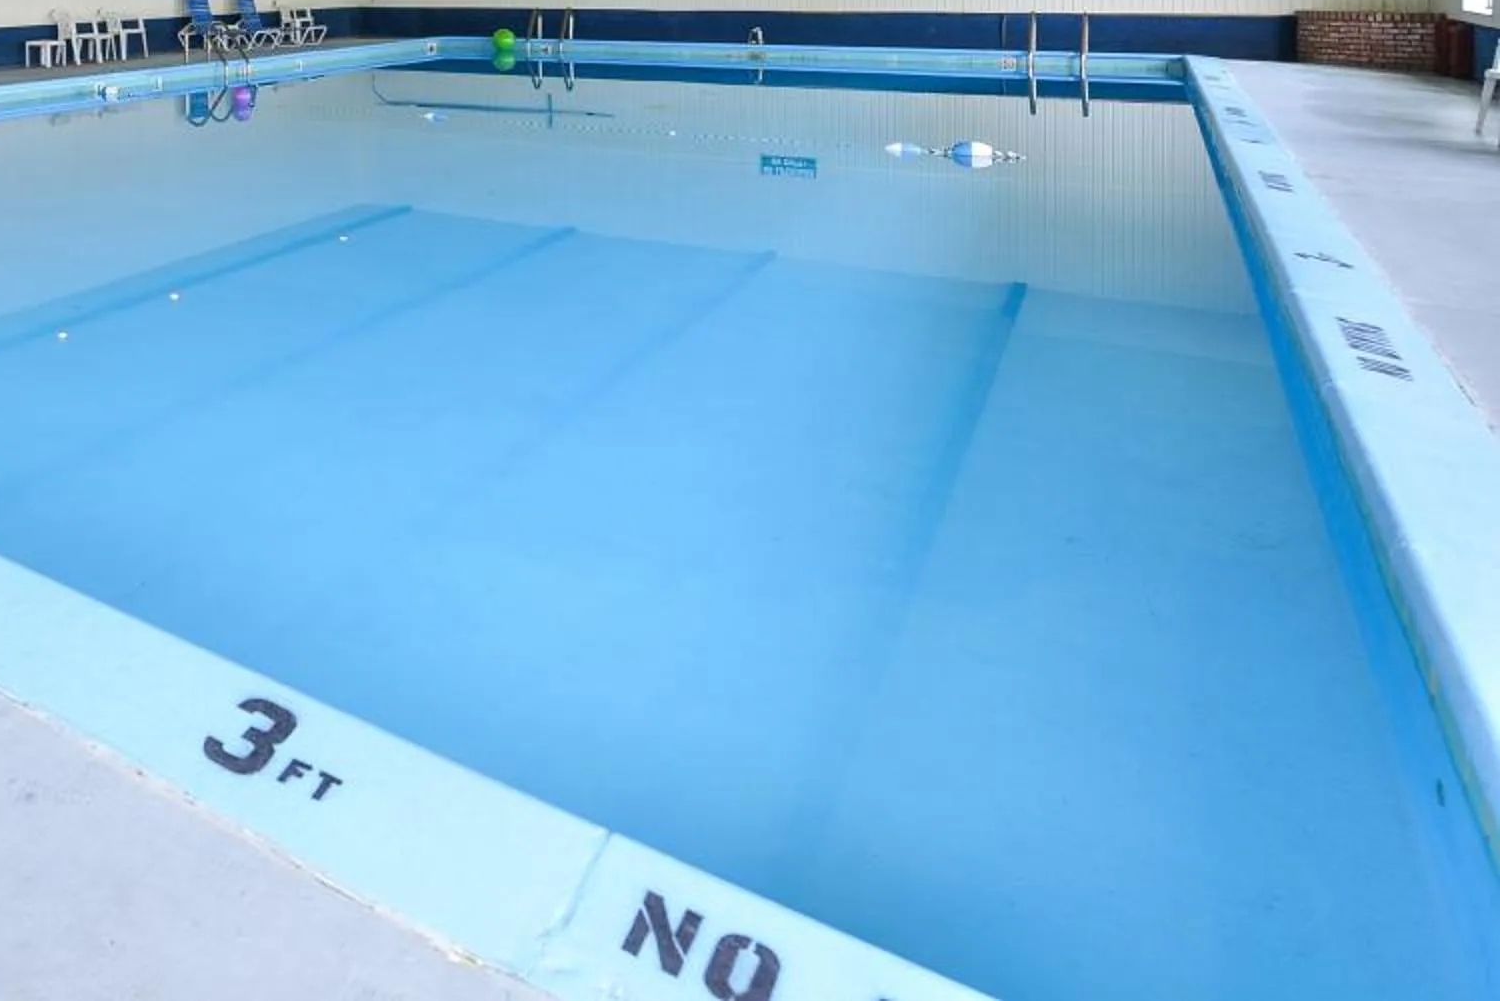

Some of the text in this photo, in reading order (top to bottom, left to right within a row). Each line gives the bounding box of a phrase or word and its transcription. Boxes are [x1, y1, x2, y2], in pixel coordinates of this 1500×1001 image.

[203, 698, 343, 802] 3 FT
[622, 889, 781, 1001] NO
